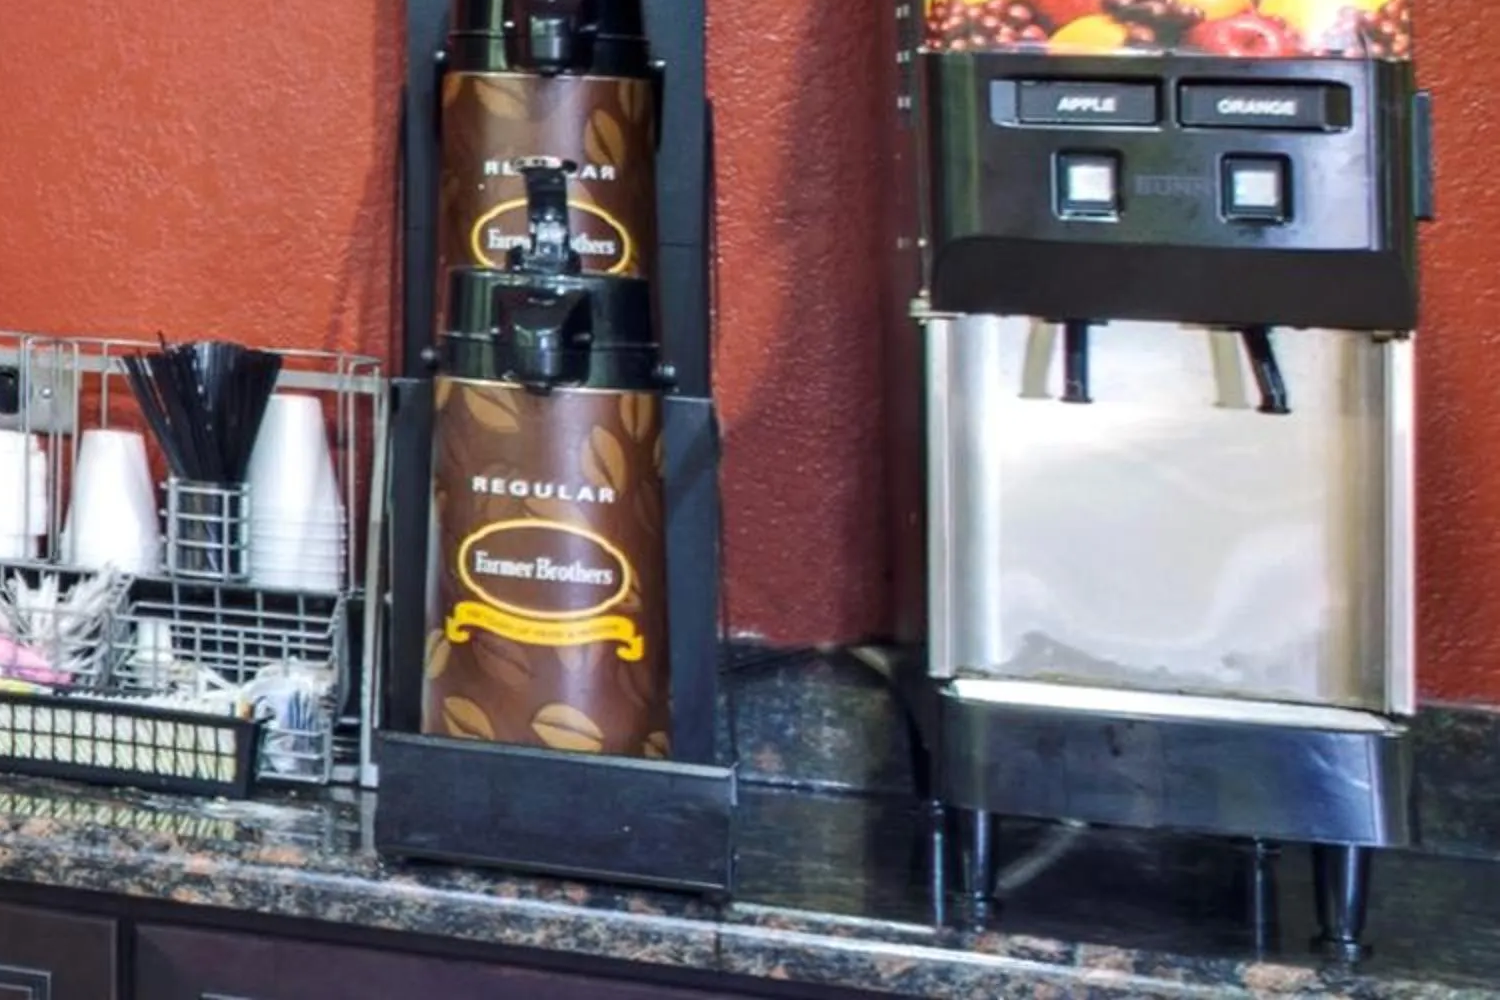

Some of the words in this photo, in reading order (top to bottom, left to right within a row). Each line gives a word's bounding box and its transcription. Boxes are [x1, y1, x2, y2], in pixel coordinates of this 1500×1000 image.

[1057, 96, 1117, 113] APPLE
[1217, 97, 1297, 116] ORANGE
[472, 476, 616, 503] REGULAR
[474, 550, 534, 578] Farmer
[536, 556, 613, 585] Brothers
